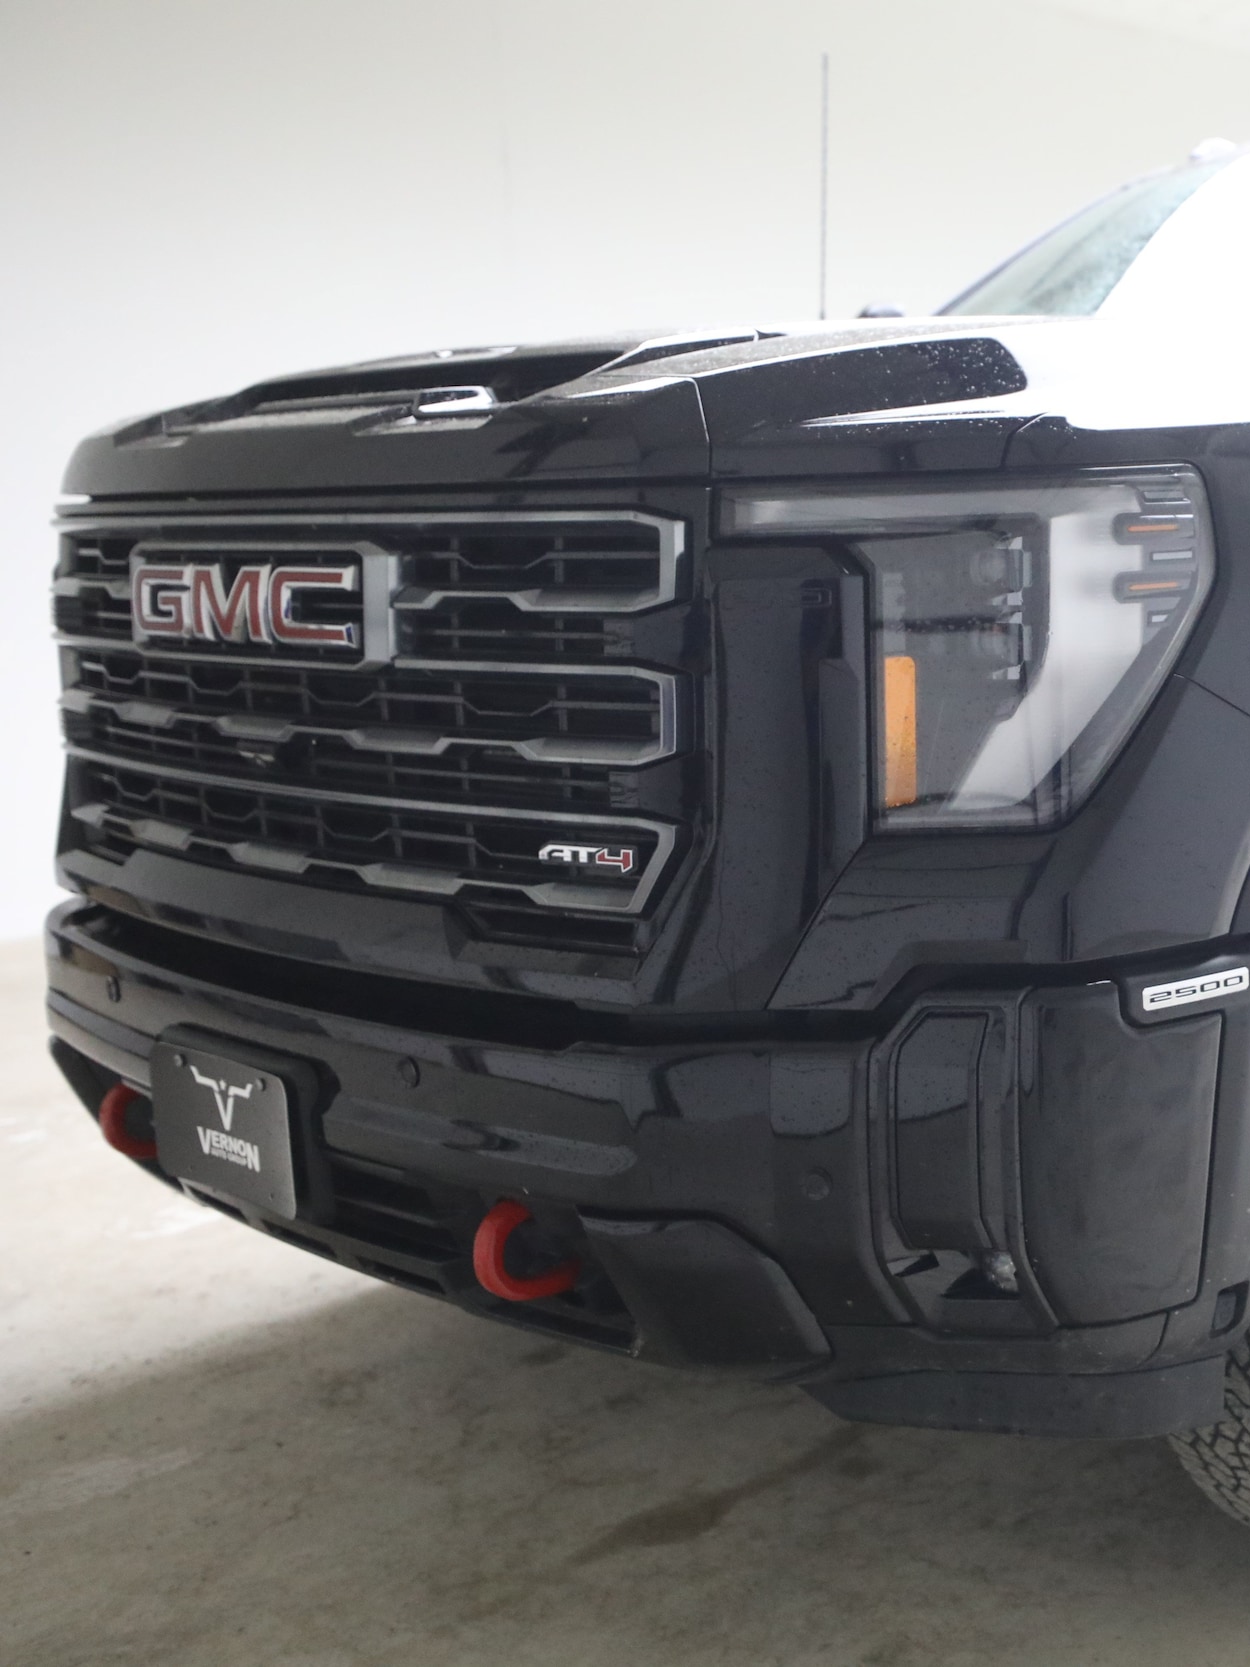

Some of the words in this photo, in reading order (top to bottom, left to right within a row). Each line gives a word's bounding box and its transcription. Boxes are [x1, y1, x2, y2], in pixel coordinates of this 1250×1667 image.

[133, 563, 356, 648] GMC
[538, 844, 633, 873] AT4
[1149, 974, 1244, 1004] 2500
[197, 1126, 261, 1173] VERNON
